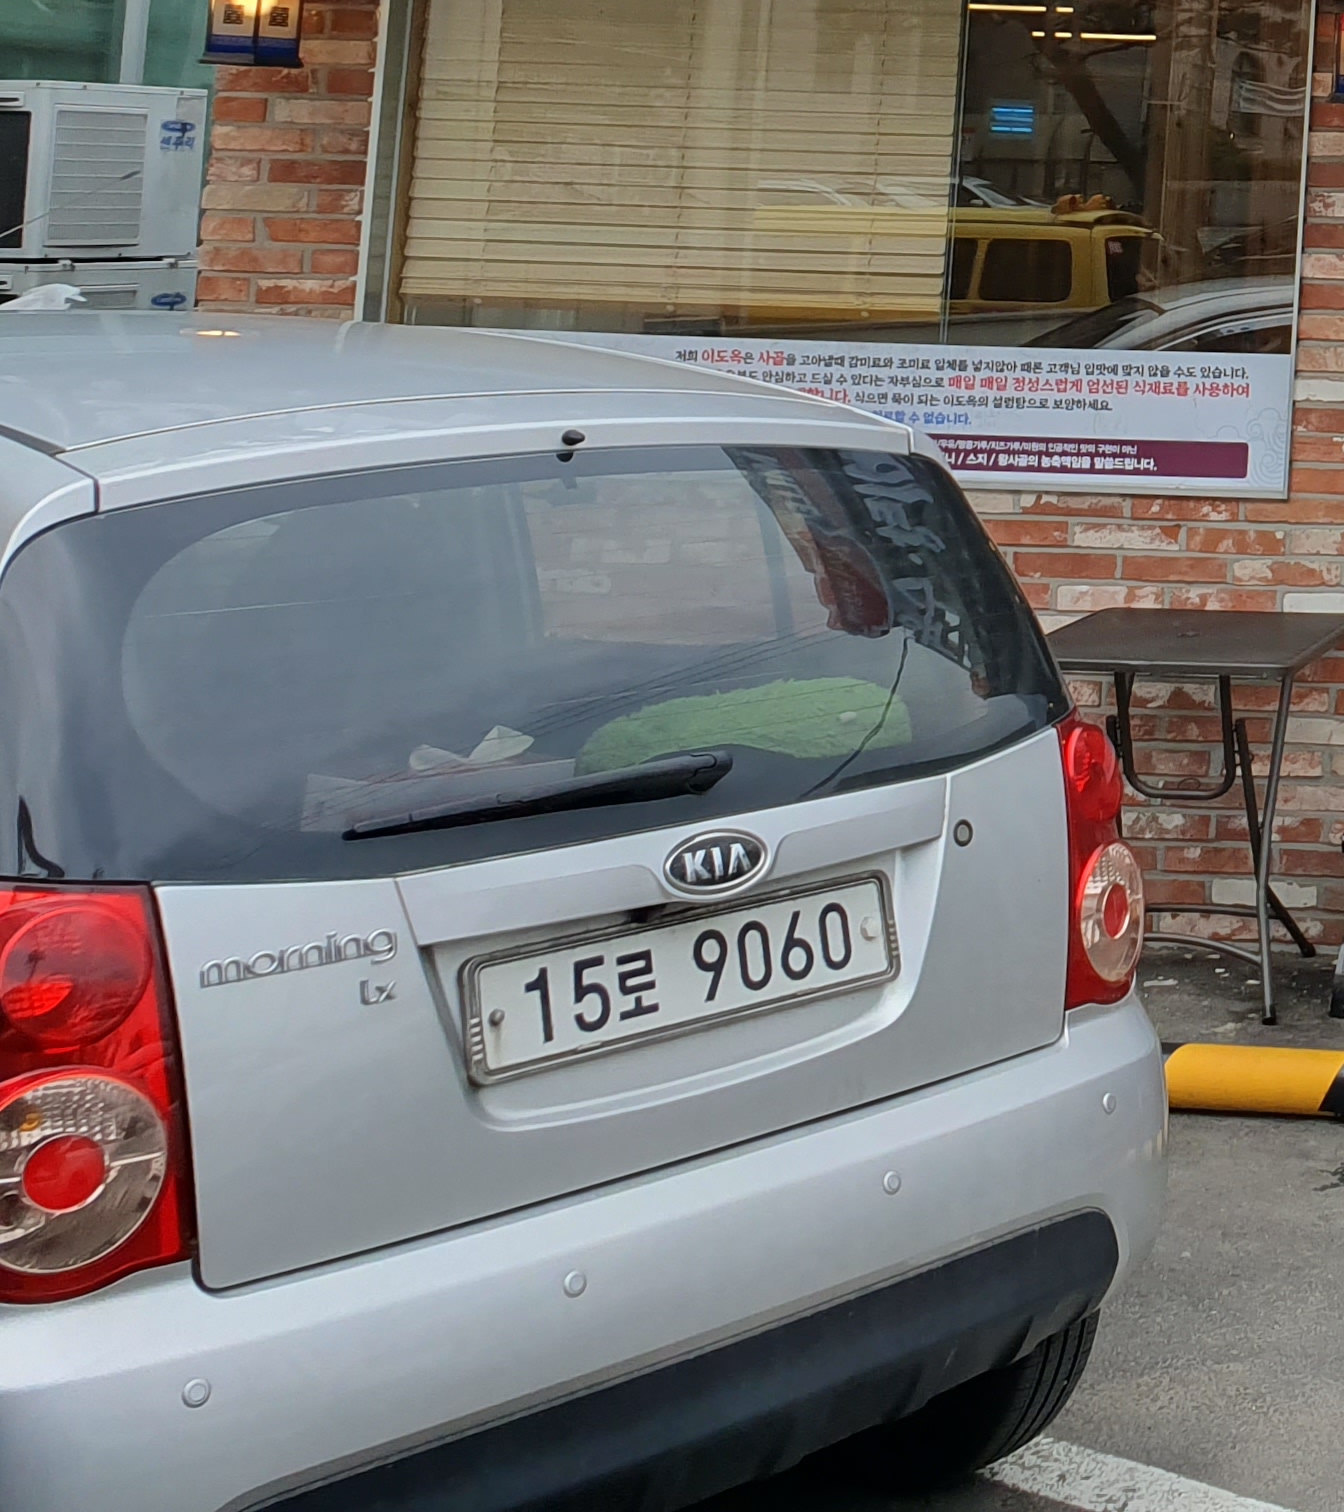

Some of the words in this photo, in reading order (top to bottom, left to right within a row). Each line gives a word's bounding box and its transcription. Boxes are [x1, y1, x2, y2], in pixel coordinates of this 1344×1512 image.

[675, 349, 699, 363] 저희
[701, 348, 755, 365] 이도옥은
[758, 350, 797, 367] 사골을
[799, 354, 845, 368] 고아낼때
[848, 356, 894, 370] 감미료와
[896, 357, 932, 370] 조미료
[934, 359, 969, 372] 일체를
[1020, 361, 1043, 372] 때론
[1045, 362, 1081, 375] 고객님
[1084, 362, 1119, 376] 입맛에
[1121, 364, 1145, 377] 맞지
[1148, 365, 1171, 379] 않을
[1173, 366, 1198, 379] 수도
[1200, 366, 1249, 381] 있습니다.
[762, 371, 808, 384] 안심하고
[810, 373, 834, 385] 드실
[836, 374, 848, 386] 수
[887, 375, 945, 389] 자부심으로
[948, 375, 976, 391] 매일
[979, 376, 1009, 392] 매일
[1012, 377, 1084, 394] 정성스럽게
[1086, 378, 1129, 395] 엄선된
[1133, 380, 1190, 397] 식재료를
[1193, 382, 1250, 399] 사용하여
[855, 392, 888, 405] 식으면
[891, 393, 914, 406] 묵이
[917, 394, 941, 407] 되는
[943, 394, 989, 409] 이도옥의
[992, 396, 1050, 410] 설렁탕으로
[923, 411, 972, 425] 없습니다.
[682, 839, 754, 884] KIA
[200, 927, 398, 990] morning
[524, 948, 661, 1045] 15로
[692, 901, 854, 1003] 9060
